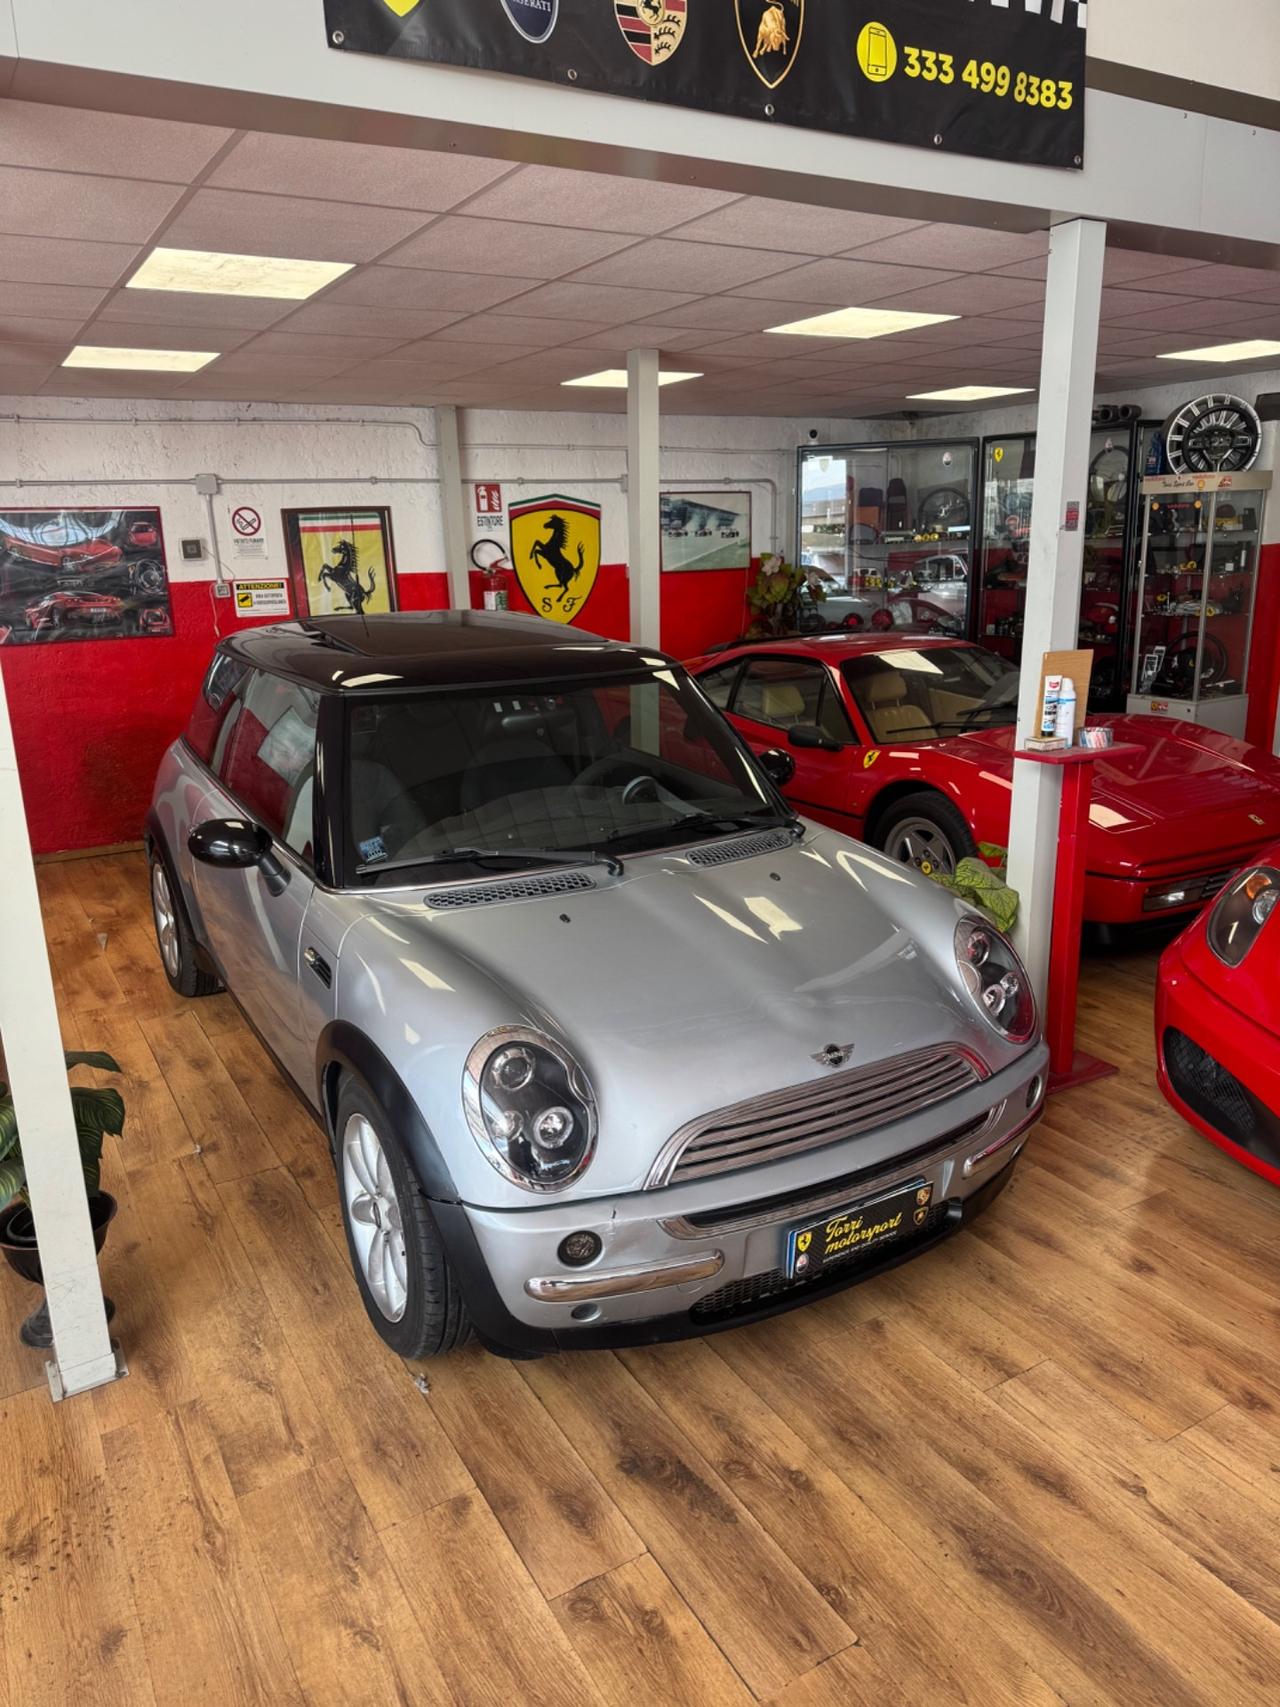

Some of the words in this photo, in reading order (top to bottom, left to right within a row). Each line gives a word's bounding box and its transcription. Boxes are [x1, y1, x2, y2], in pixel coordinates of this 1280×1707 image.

[903, 46, 955, 85] 333
[961, 60, 1011, 97] 499
[1013, 71, 1073, 110] 8383
[541, 597, 553, 613] S
[562, 596, 583, 613] F
[825, 1215, 864, 1242] Torri
[825, 1212, 903, 1255] motorsport
